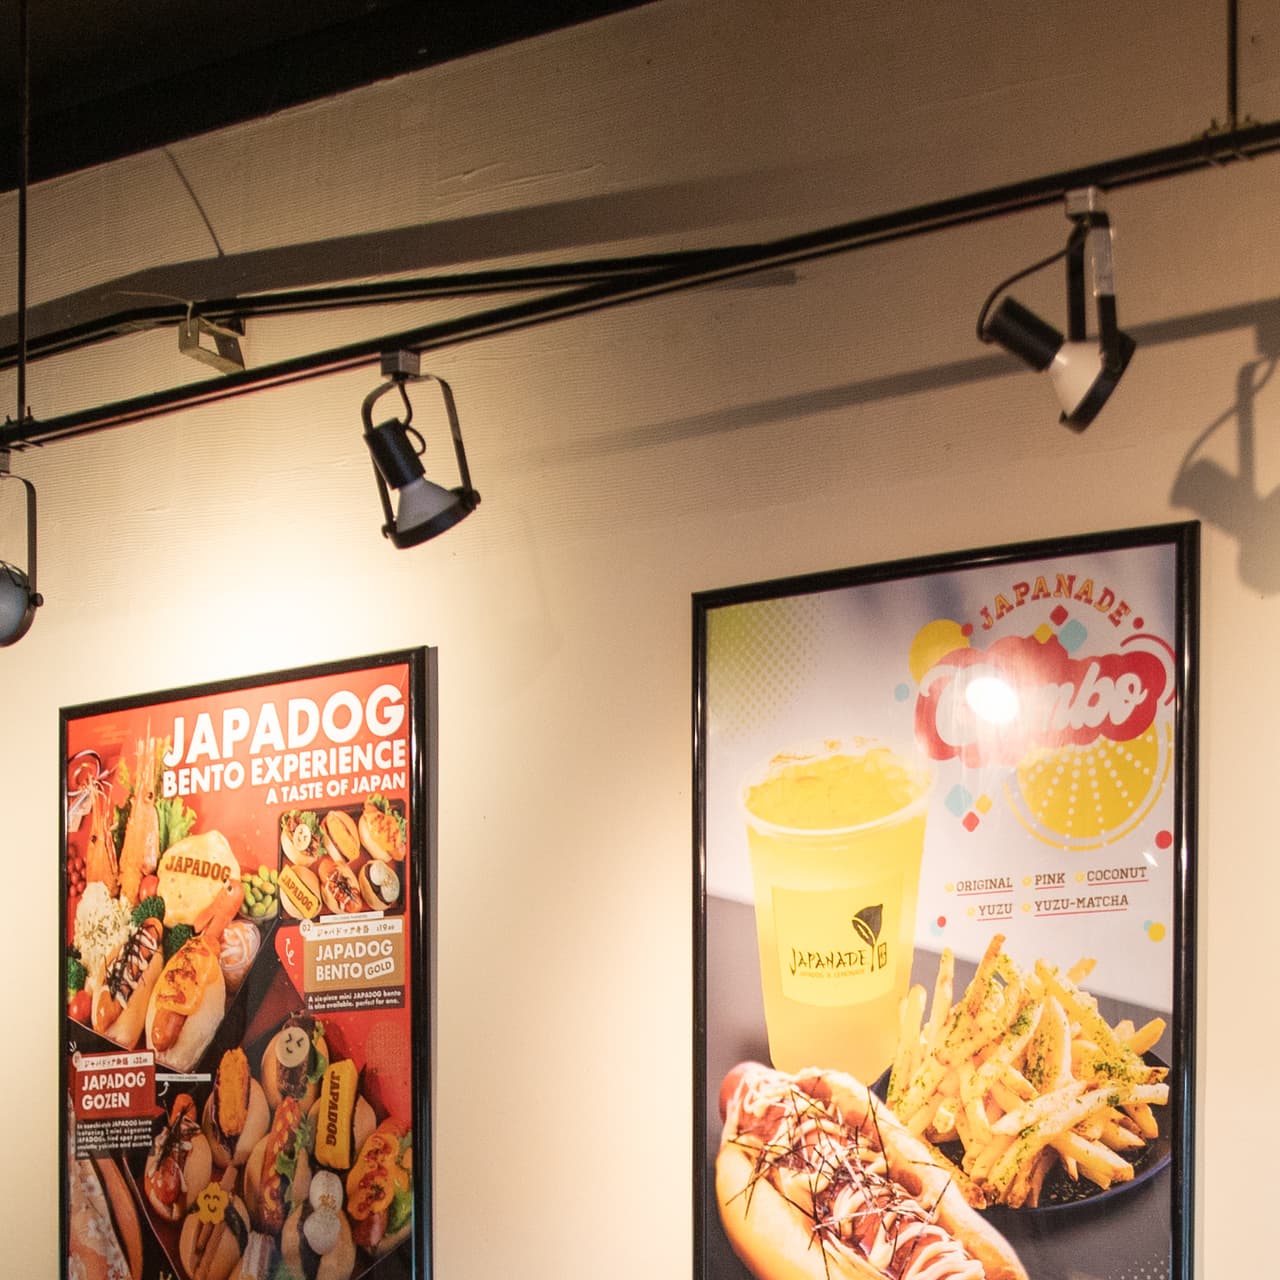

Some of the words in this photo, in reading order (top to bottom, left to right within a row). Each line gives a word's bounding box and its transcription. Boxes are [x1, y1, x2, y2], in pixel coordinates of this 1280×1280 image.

[979, 573, 1132, 630] JAPANADE
[920, 661, 1147, 747] Cmbo
[163, 684, 406, 768] JAPADOG
[163, 763, 245, 798] BENTO
[251, 739, 406, 787] EXPERIENCE
[266, 789, 279, 805] A
[281, 783, 323, 803] TASTE
[326, 781, 348, 796] OF
[351, 772, 406, 794] JAPAN
[165, 856, 231, 882] JAPADOG
[956, 877, 1013, 892] ORIGINAL
[1035, 872, 1066, 886] PINK
[1087, 866, 1147, 882] COCONUT
[280, 873, 314, 911] JAPADOG
[978, 903, 1012, 916] YUZU
[1035, 894, 1129, 912] YUZU-MATCHA
[316, 939, 393, 962] JAPADOG
[789, 947, 865, 977] JAPANADE
[316, 962, 362, 981] BENTO
[367, 961, 392, 976] GOLD
[82, 1072, 146, 1091] JAPADOG
[82, 1092, 130, 1110] GOZEN
[326, 1070, 340, 1147] JAPADOG
